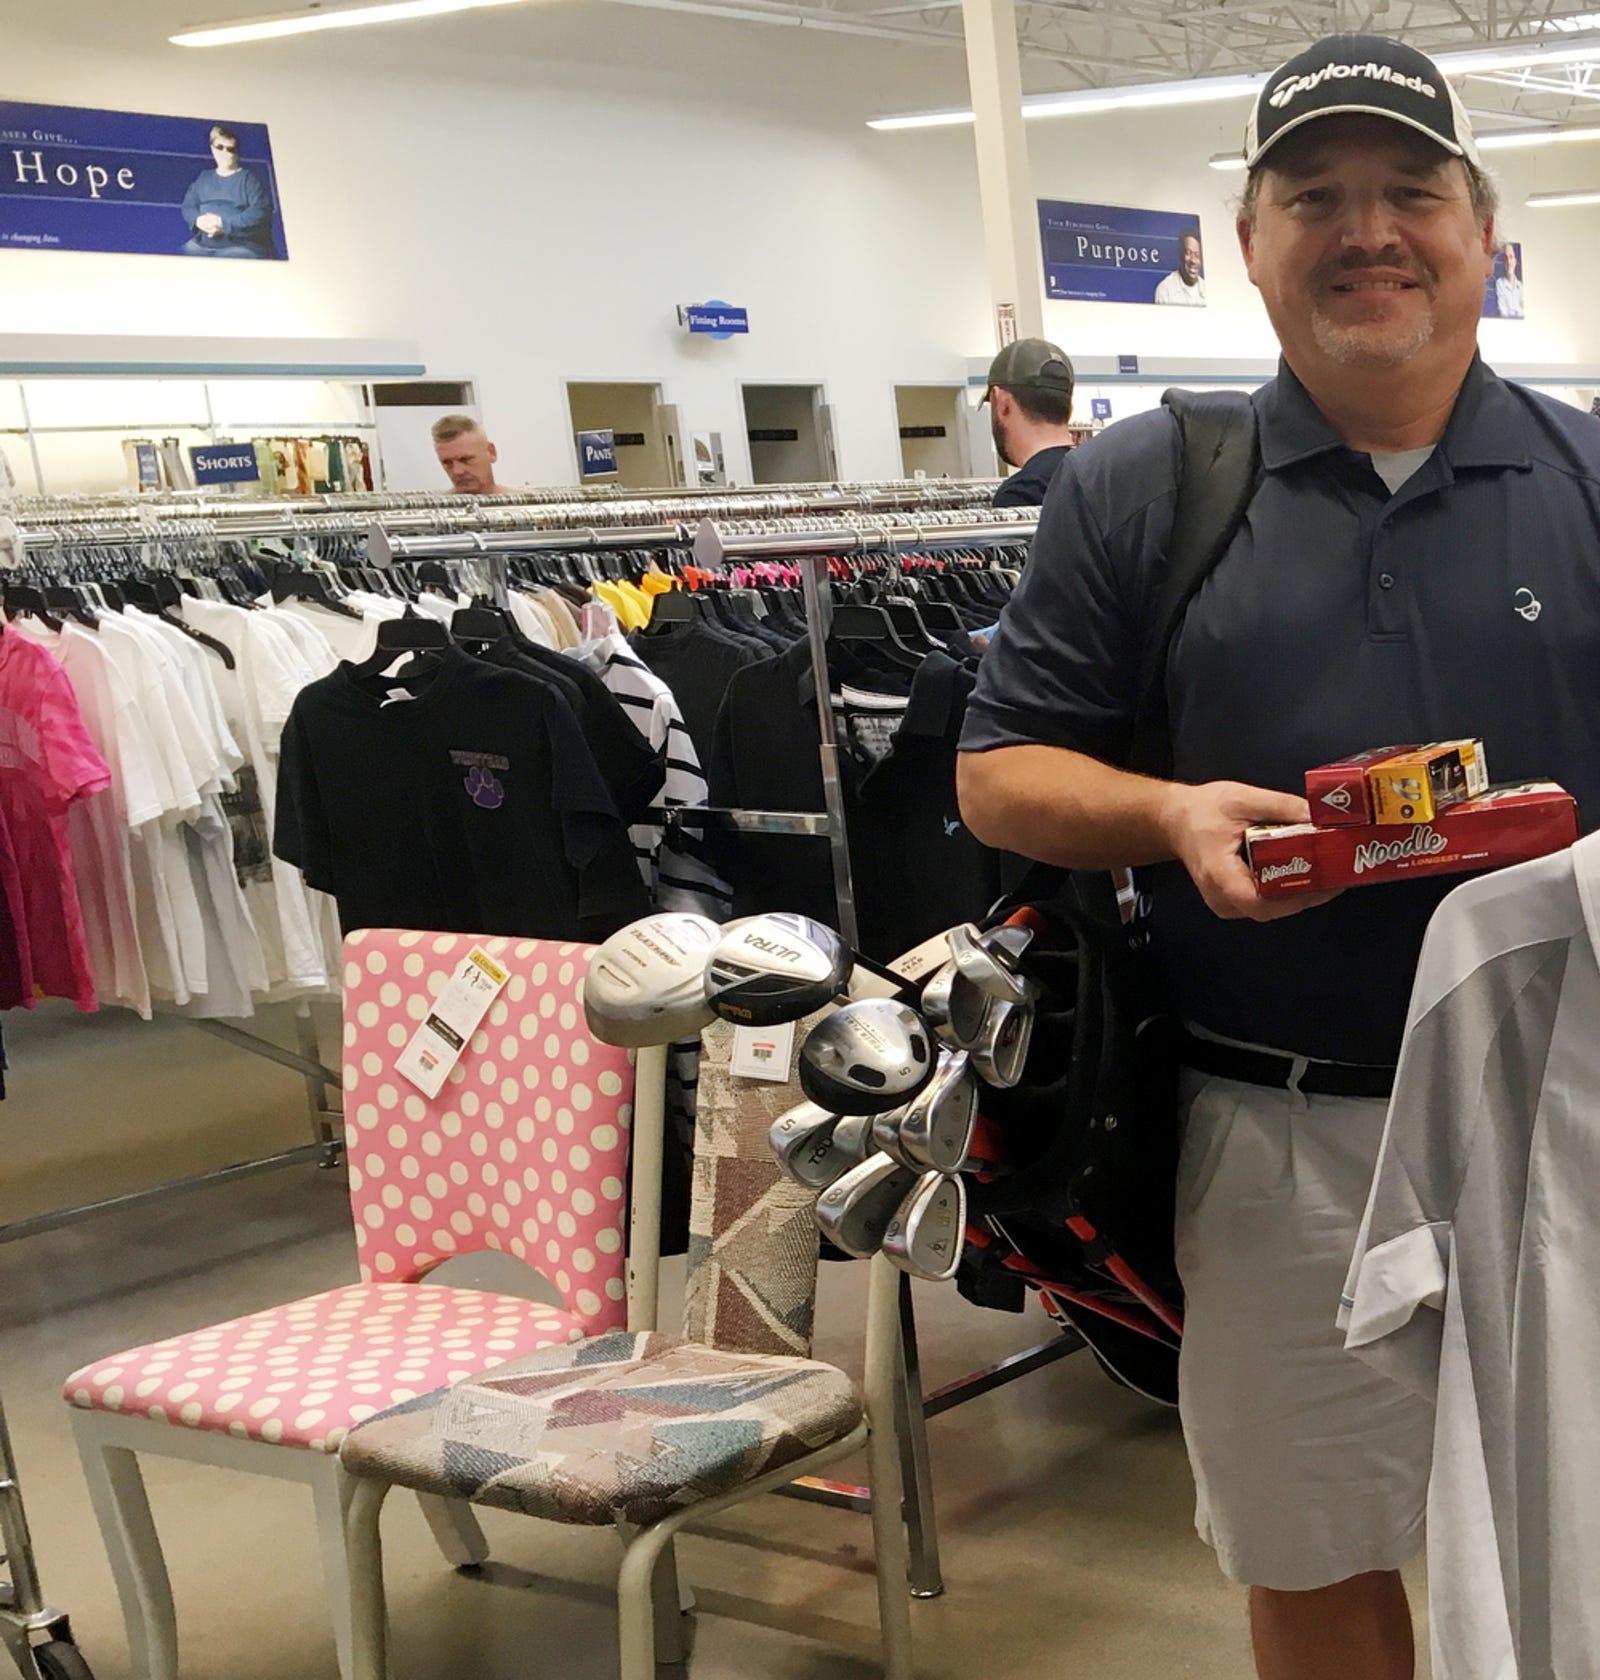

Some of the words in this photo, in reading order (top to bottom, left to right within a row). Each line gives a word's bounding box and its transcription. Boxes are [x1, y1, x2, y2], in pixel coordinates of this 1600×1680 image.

[1269, 63, 1436, 109] TaylorMade
[12, 150, 136, 198] Hope
[1076, 236, 1160, 267] Purpose
[690, 314, 718, 328] Fitting
[718, 315, 746, 325] Rooms
[196, 455, 252, 471] SHORTS
[586, 445, 612, 462] PANTS
[1354, 825, 1448, 873] Noodle
[1261, 856, 1312, 883] Noodle
[1411, 854, 1460, 867] LONGEST
[744, 933, 801, 964] ULTRA
[780, 1118, 797, 1133] 5
[828, 1187, 844, 1205] 8
